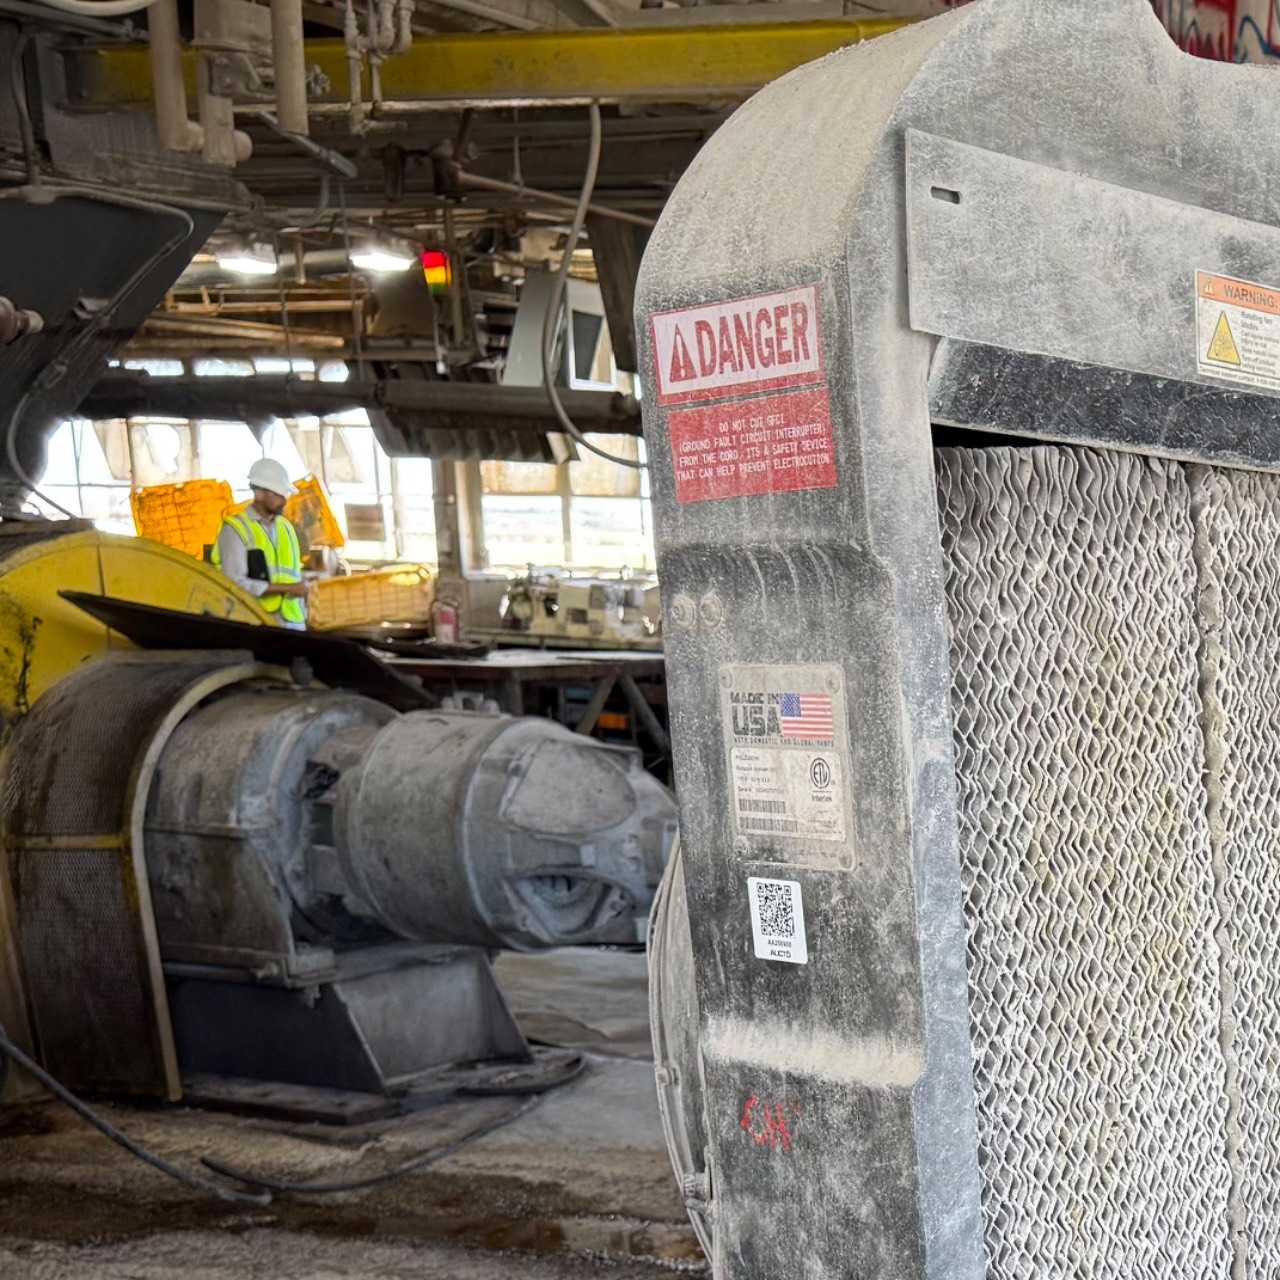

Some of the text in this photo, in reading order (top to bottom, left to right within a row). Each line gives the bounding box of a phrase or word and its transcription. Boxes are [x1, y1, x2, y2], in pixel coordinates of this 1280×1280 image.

[694, 301, 810, 378] DANGER
[714, 435, 737, 447] FAULT
[740, 430, 772, 445] CIRCUIT
[719, 422, 729, 433] DO
[732, 419, 745, 431] NOT
[679, 455, 699, 467] FROM
[702, 453, 717, 464] THE
[773, 441, 798, 456] SAFETY
[800, 438, 829, 451] DEVICE
[676, 453, 830, 481] THAT CAN HELP PREVENT ELECTROCUTION
[730, 691, 780, 705] MADE IN
[732, 705, 781, 736] USA
